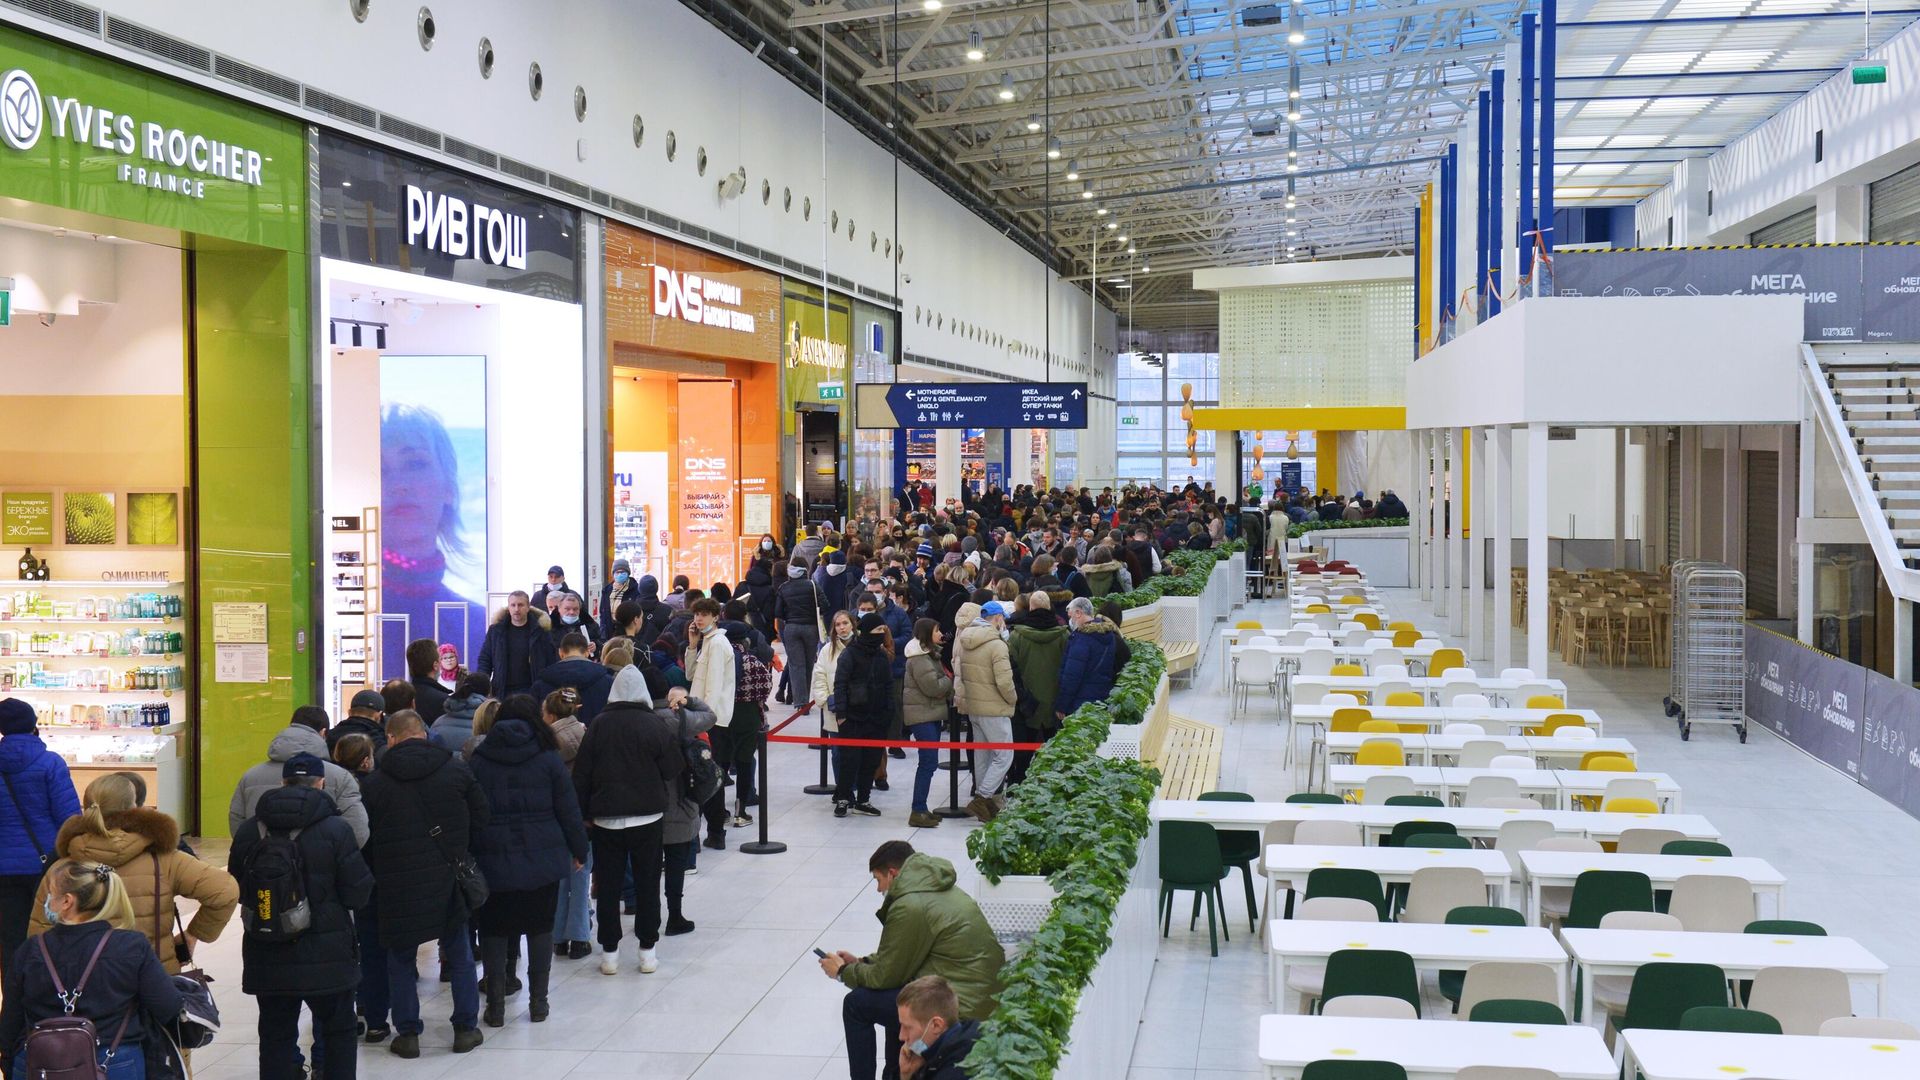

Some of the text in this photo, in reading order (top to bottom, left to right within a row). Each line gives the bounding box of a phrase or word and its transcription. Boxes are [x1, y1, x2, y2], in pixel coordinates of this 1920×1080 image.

[46, 96, 262, 186] YVES ROCHER
[118, 164, 204, 198] FRANCE
[406, 184, 527, 271] РИВ ГОШ
[1750, 273, 1806, 290] МЕГА
[654, 265, 702, 323] DNS
[684, 458, 727, 470] DNS
[686, 492, 720, 500] ВЫБИРАЙ
[6, 507, 49, 515] БЕРЕЖНЫЕ
[683, 502, 724, 510] ЗАКАЗЫВАЙ
[7, 525, 29, 536] ЭКО
[101, 571, 169, 582] ОЧИЩЕНИЕ
[1767, 660, 1780, 680] МЕГА
[1832, 690, 1848, 713] МЕГА
[1822, 704, 1856, 733] обновление
